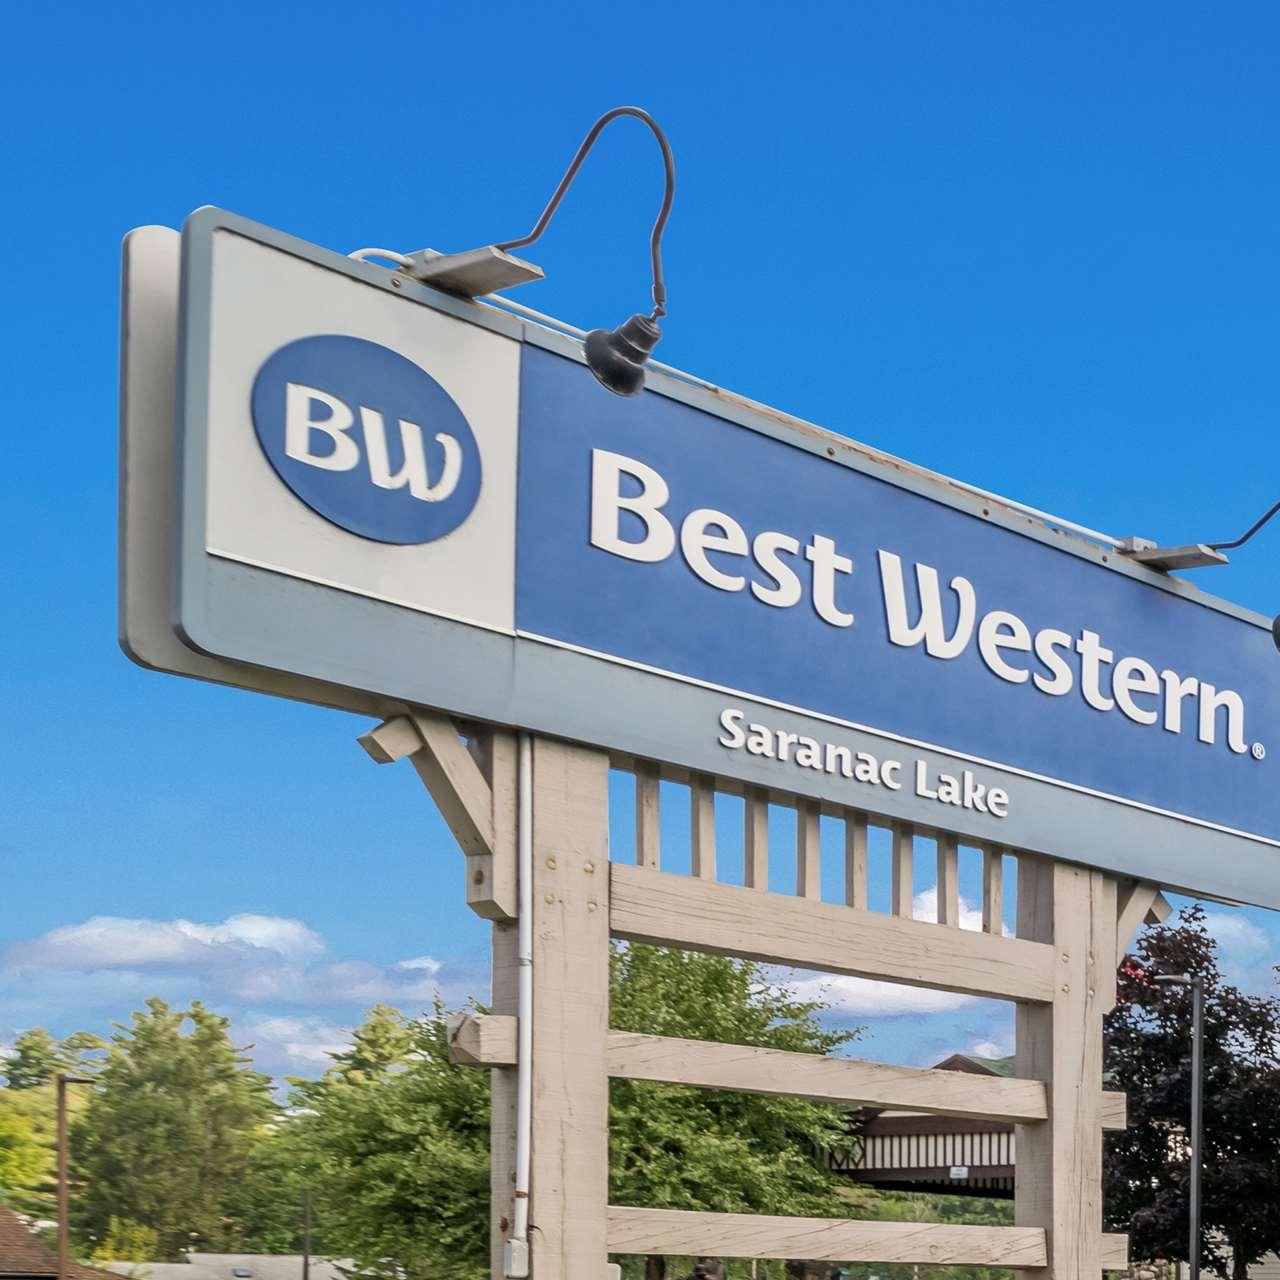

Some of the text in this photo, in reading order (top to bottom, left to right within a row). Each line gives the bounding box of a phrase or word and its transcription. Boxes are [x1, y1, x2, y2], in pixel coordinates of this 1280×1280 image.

[284, 382, 463, 503] BW
[590, 448, 855, 628] Best
[719, 708, 1010, 818] Saranac Lake
